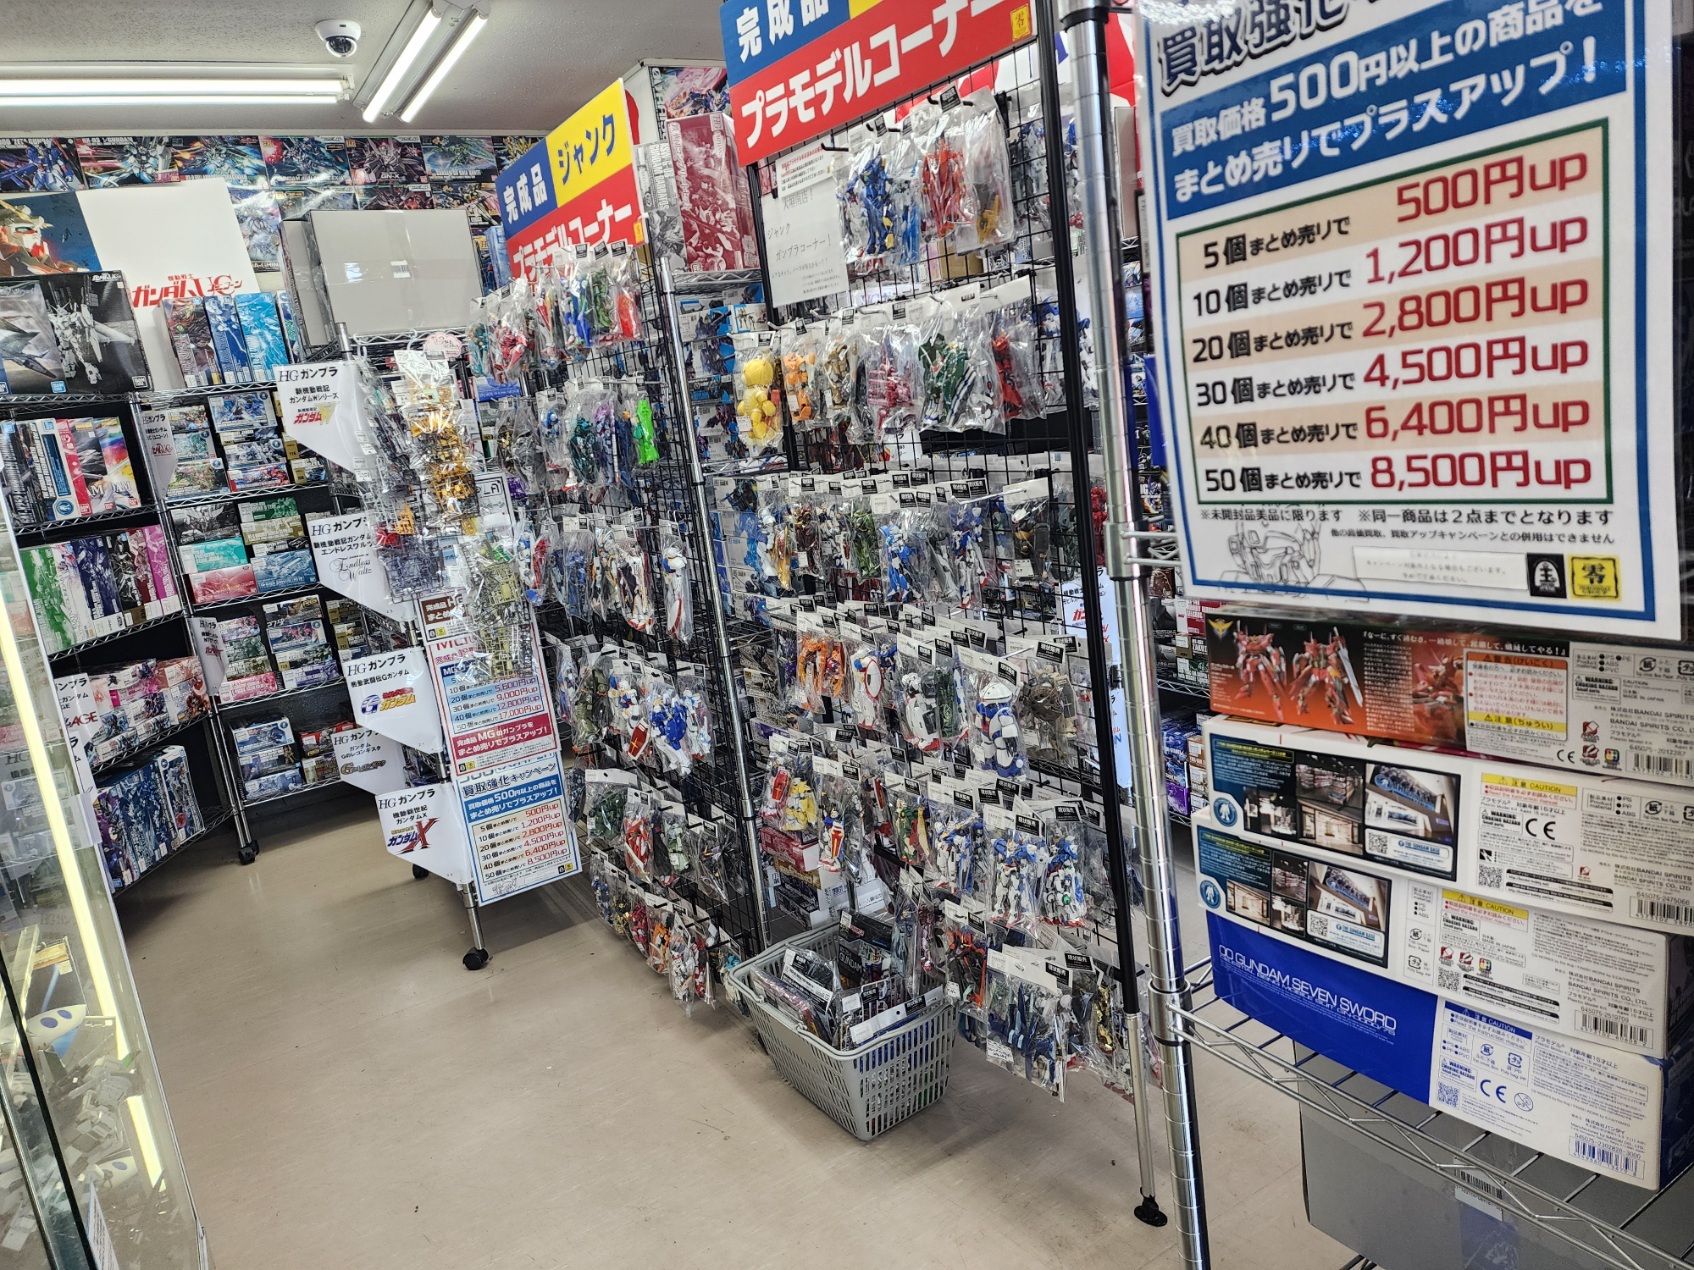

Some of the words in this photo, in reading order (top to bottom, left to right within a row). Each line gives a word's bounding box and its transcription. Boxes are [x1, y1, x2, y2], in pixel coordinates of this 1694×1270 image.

[741, 0, 1007, 149] プラモデルコーナー
[1174, 35, 1597, 203] まとめ売りでプラスアップ！
[557, 112, 616, 186] ジャンク
[503, 163, 549, 225] 完成品
[1203, 216, 1351, 269] 5個まとめ売りで
[1397, 152, 1588, 224] 500円up
[511, 198, 633, 283] プラモデルコーナー
[1193, 270, 1352, 317] 10個まとめ売りで
[1366, 215, 1588, 285] 1,200円up
[1192, 322, 1353, 363] 20個まとめ売りで
[1362, 277, 1588, 339] 2,800円up
[279, 369, 298, 382] HG
[300, 366, 339, 380] ガンプラ
[1195, 372, 1356, 406] 30個まとめ売りで
[1363, 335, 1589, 389] 4,500円up
[1200, 421, 1359, 450] 40個まとめ売りで
[1365, 393, 1590, 442] 6,400円up
[1205, 467, 1362, 493] 50個まとめ売りで
[1370, 450, 1592, 491] 8,500円up
[311, 524, 331, 536] HG
[1200, 508, 1343, 522] ※未開封品美品に限ります
[347, 664, 367, 676] HG
[368, 654, 406, 671] ガンプラ
[333, 735, 349, 746] HG
[379, 798, 396, 810] HG
[398, 788, 436, 805] ガンプラ
[1529, 782, 1561, 793] CAUTION
[1485, 902, 1515, 915] CAUTION
[1235, 952, 1290, 986] GUNDAM
[1291, 977, 1337, 1006] SEVEN
[1340, 997, 1397, 1031] SWORD
[1488, 1018, 1516, 1034] CAUTION
